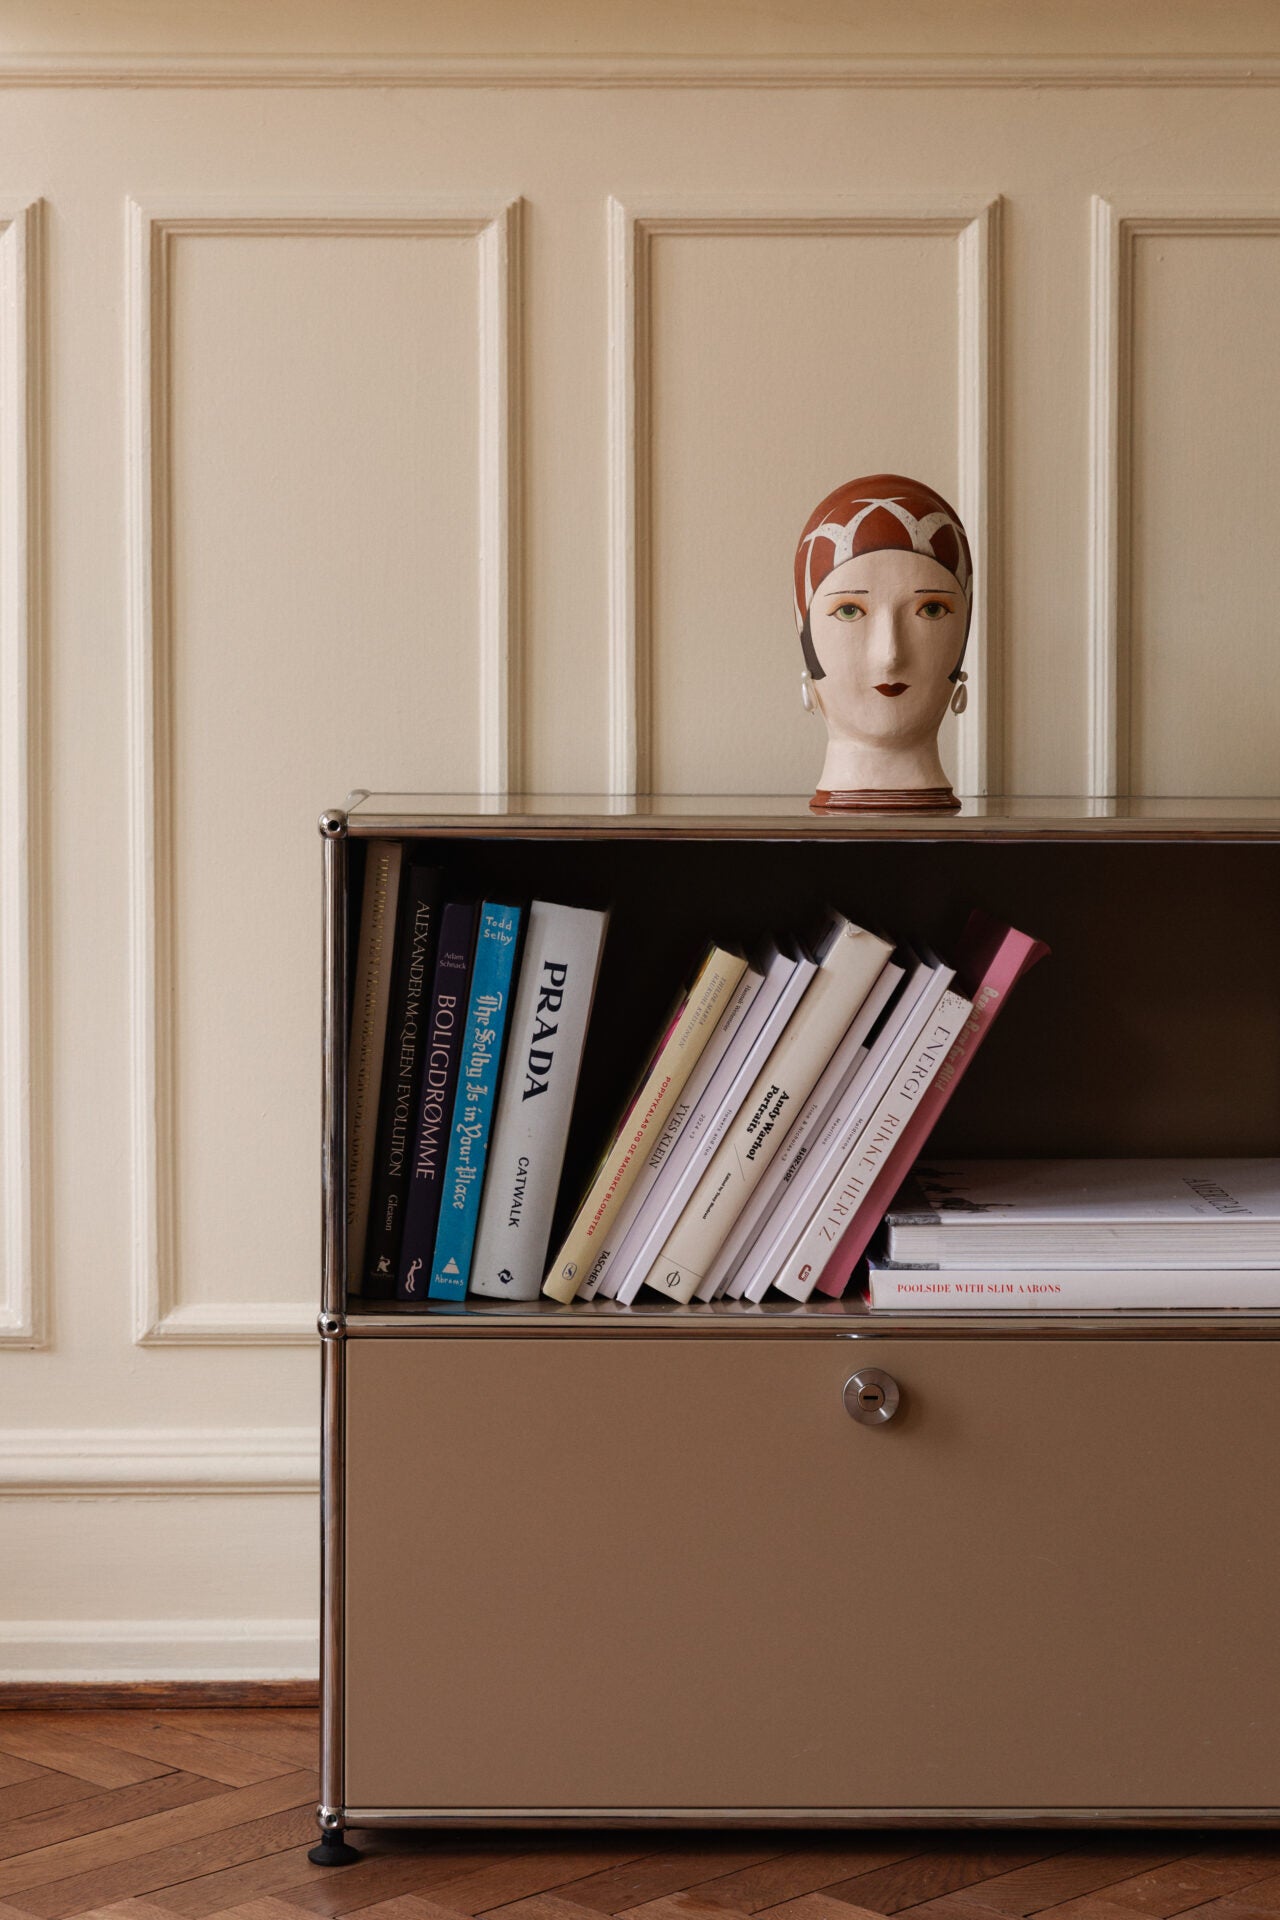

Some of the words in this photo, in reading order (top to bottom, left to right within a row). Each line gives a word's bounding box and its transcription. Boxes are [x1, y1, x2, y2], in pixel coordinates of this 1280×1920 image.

[484, 929, 512, 945] Selby
[486, 917, 512, 930] Todd
[407, 900, 429, 997] ALEXANDER
[440, 960, 466, 970] Schnack
[444, 952, 464, 960] Adam
[473, 991, 502, 1025] The
[399, 1001, 419, 1077] McQUEEN
[521, 960, 567, 1101] PRADA
[465, 1027, 495, 1077] Selby
[899, 1025, 950, 1100] ENERGI
[415, 994, 456, 1179] BOLIGDRØMME
[640, 1076, 671, 1129] POPPYKALAS
[463, 1106, 482, 1123] in
[667, 1102, 689, 1132] YVES
[694, 1113, 705, 1129] 2024
[746, 1084, 779, 1133] Portraits
[768, 1090, 789, 1121] Andy
[805, 1103, 817, 1119] Trine
[388, 1084, 410, 1176] EVOLUTION
[455, 1123, 482, 1164] Your
[633, 1130, 643, 1142] OG
[745, 1122, 774, 1160] Warhol
[858, 1113, 900, 1171] RIKKE
[627, 1143, 637, 1155] DE
[648, 1132, 673, 1168] KLEIN
[783, 1147, 806, 1182] 2017-2018
[452, 1165, 476, 1209] Place
[508, 1156, 529, 1227] CATWALK
[608, 1155, 630, 1192] MAGISKE
[385, 1194, 397, 1230] Gleason
[586, 1192, 611, 1236] BLOMSTER
[818, 1176, 863, 1241] HERTZ
[435, 1274, 464, 1286] Abrams
[585, 1250, 610, 1286] TASCHEN
[898, 1284, 950, 1293] POOLSIDE
[956, 1284, 984, 1293] WITH
[987, 1284, 1013, 1293] SLIM
[1018, 1284, 1061, 1293] AARONS
